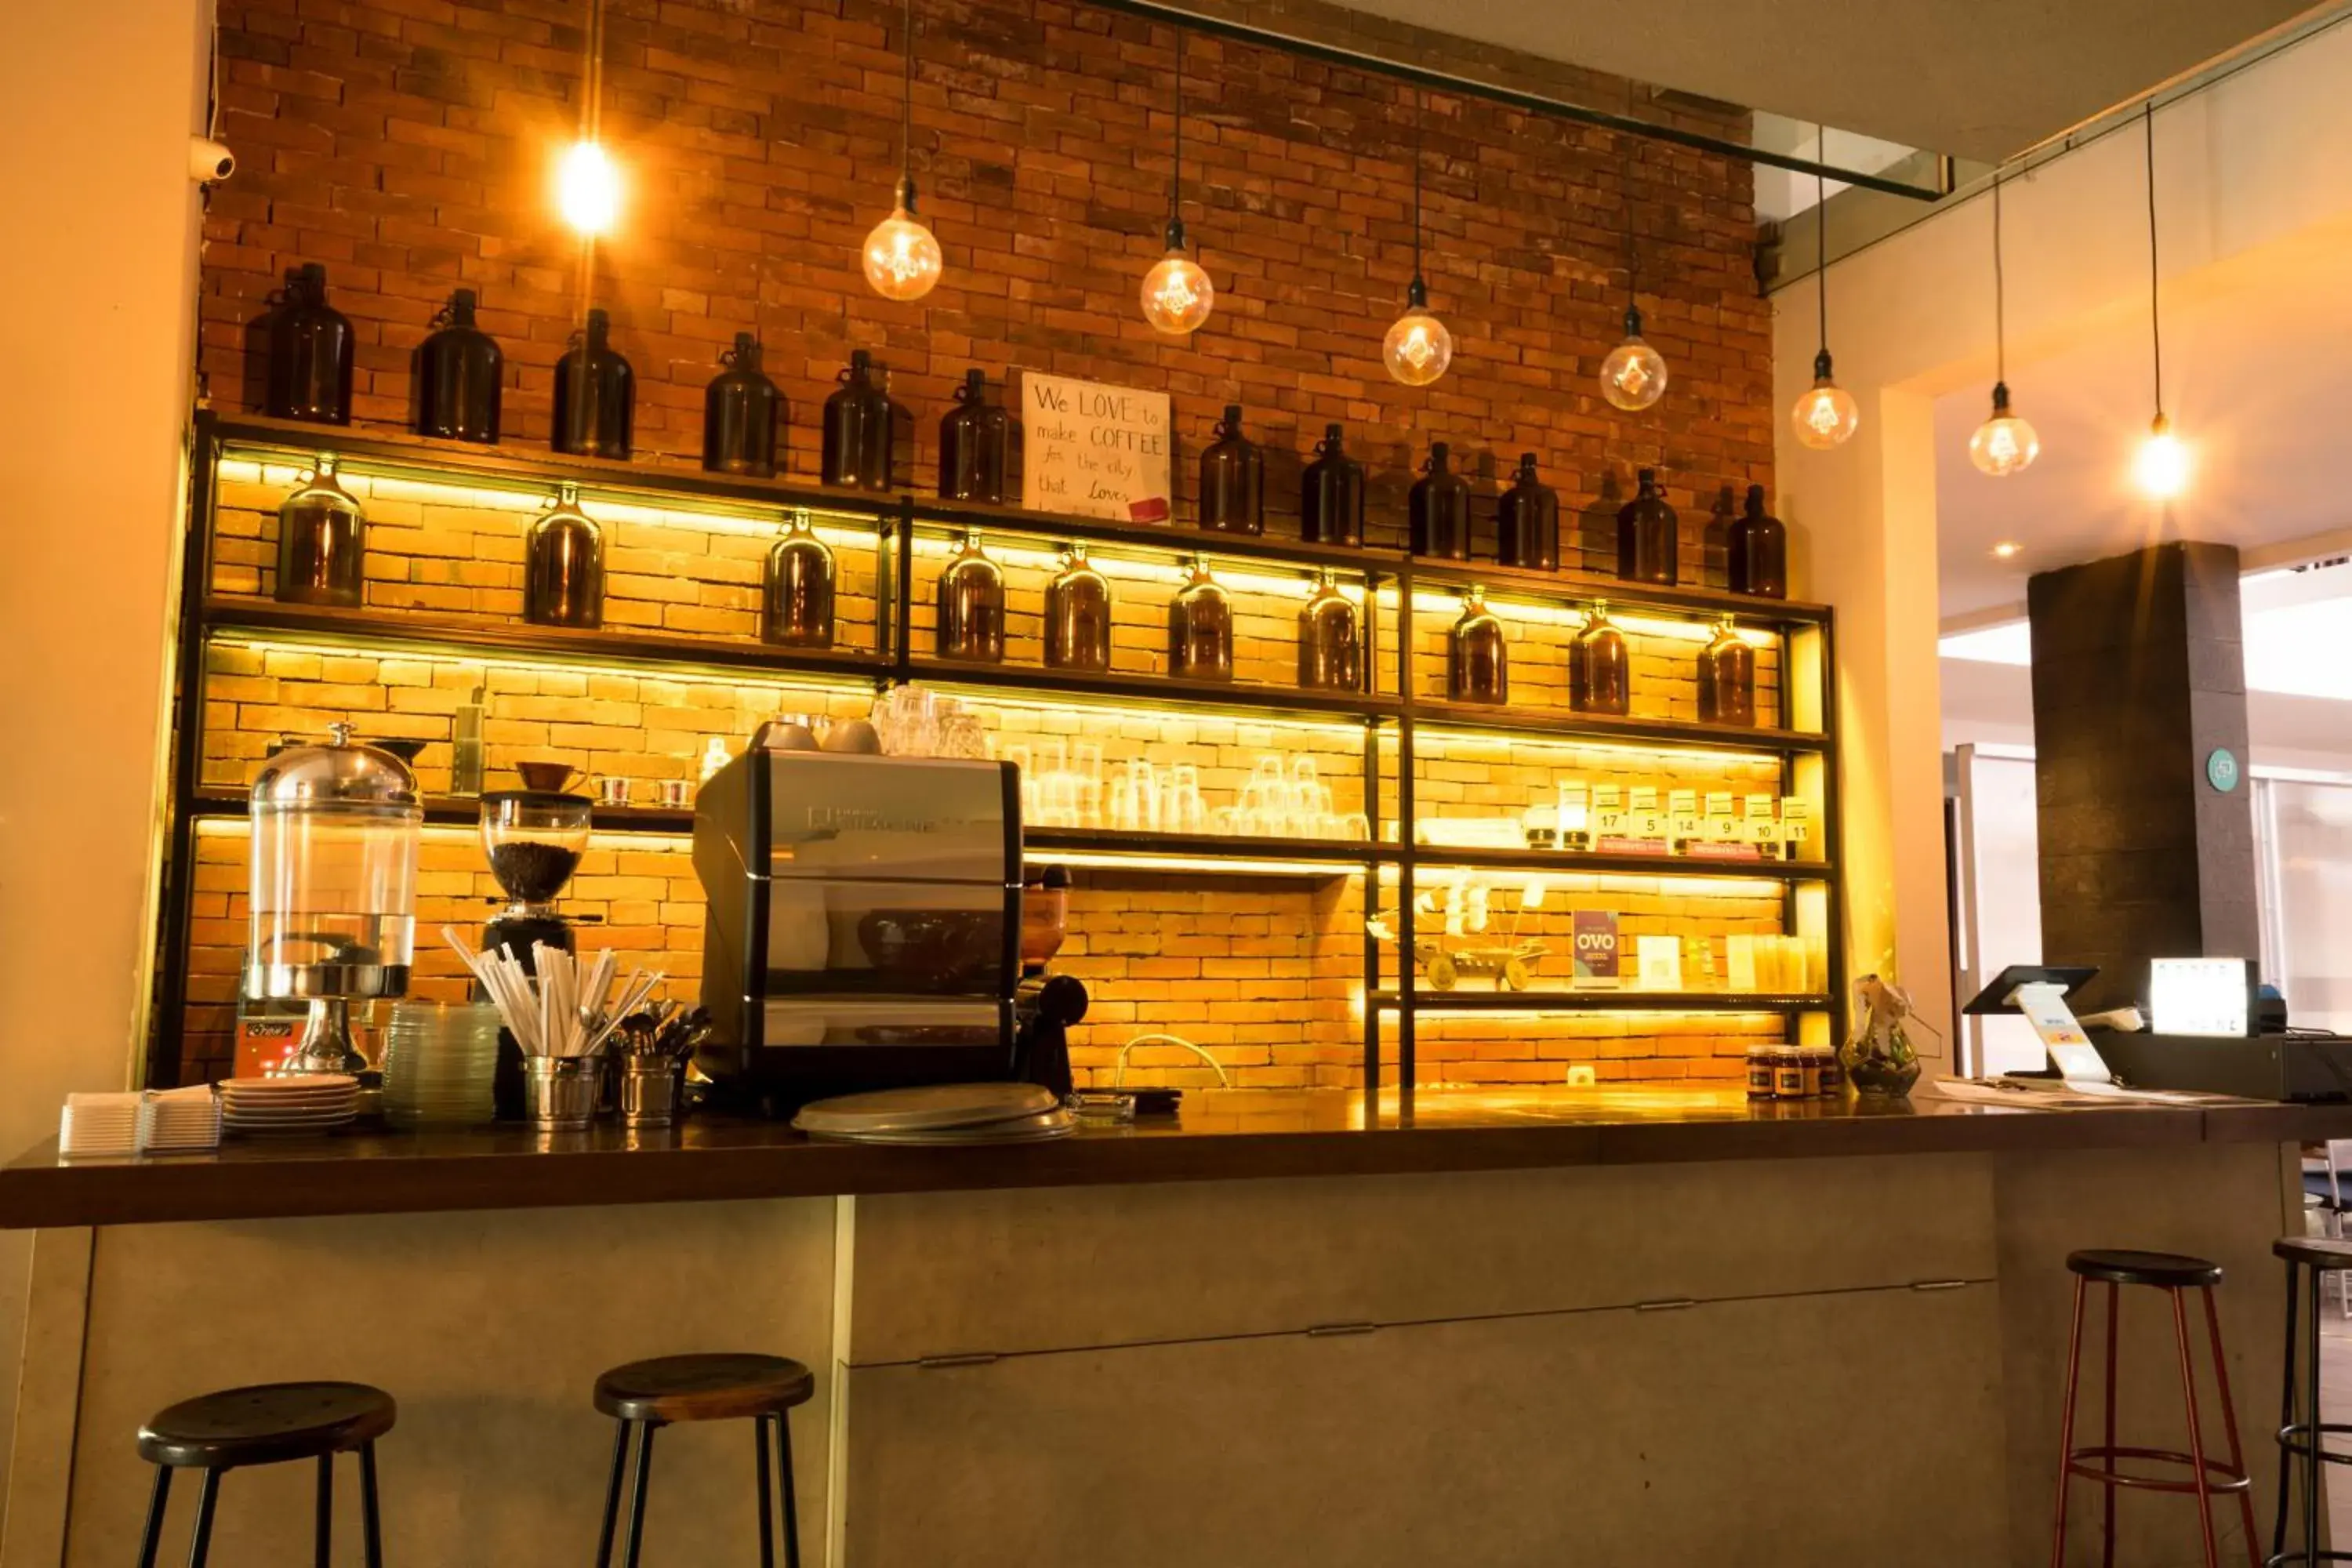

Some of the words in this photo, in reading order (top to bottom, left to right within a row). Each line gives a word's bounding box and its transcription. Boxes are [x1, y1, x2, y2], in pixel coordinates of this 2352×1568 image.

[1034, 384, 1068, 413] We
[1079, 390, 1136, 423] LOVE
[1139, 405, 1159, 426] to
[1036, 419, 1076, 444] make
[1090, 426, 1167, 455] COFFEE
[1077, 452, 1099, 470] the
[1038, 474, 1068, 494] that
[1601, 815, 1617, 827] 17
[1646, 819, 1655, 832] 5
[1679, 820, 1694, 832] 14
[1722, 822, 1731, 834] 9
[1757, 826, 1771, 838] 10
[1793, 826, 1808, 838] 11
[1577, 933, 1615, 950] OVO
